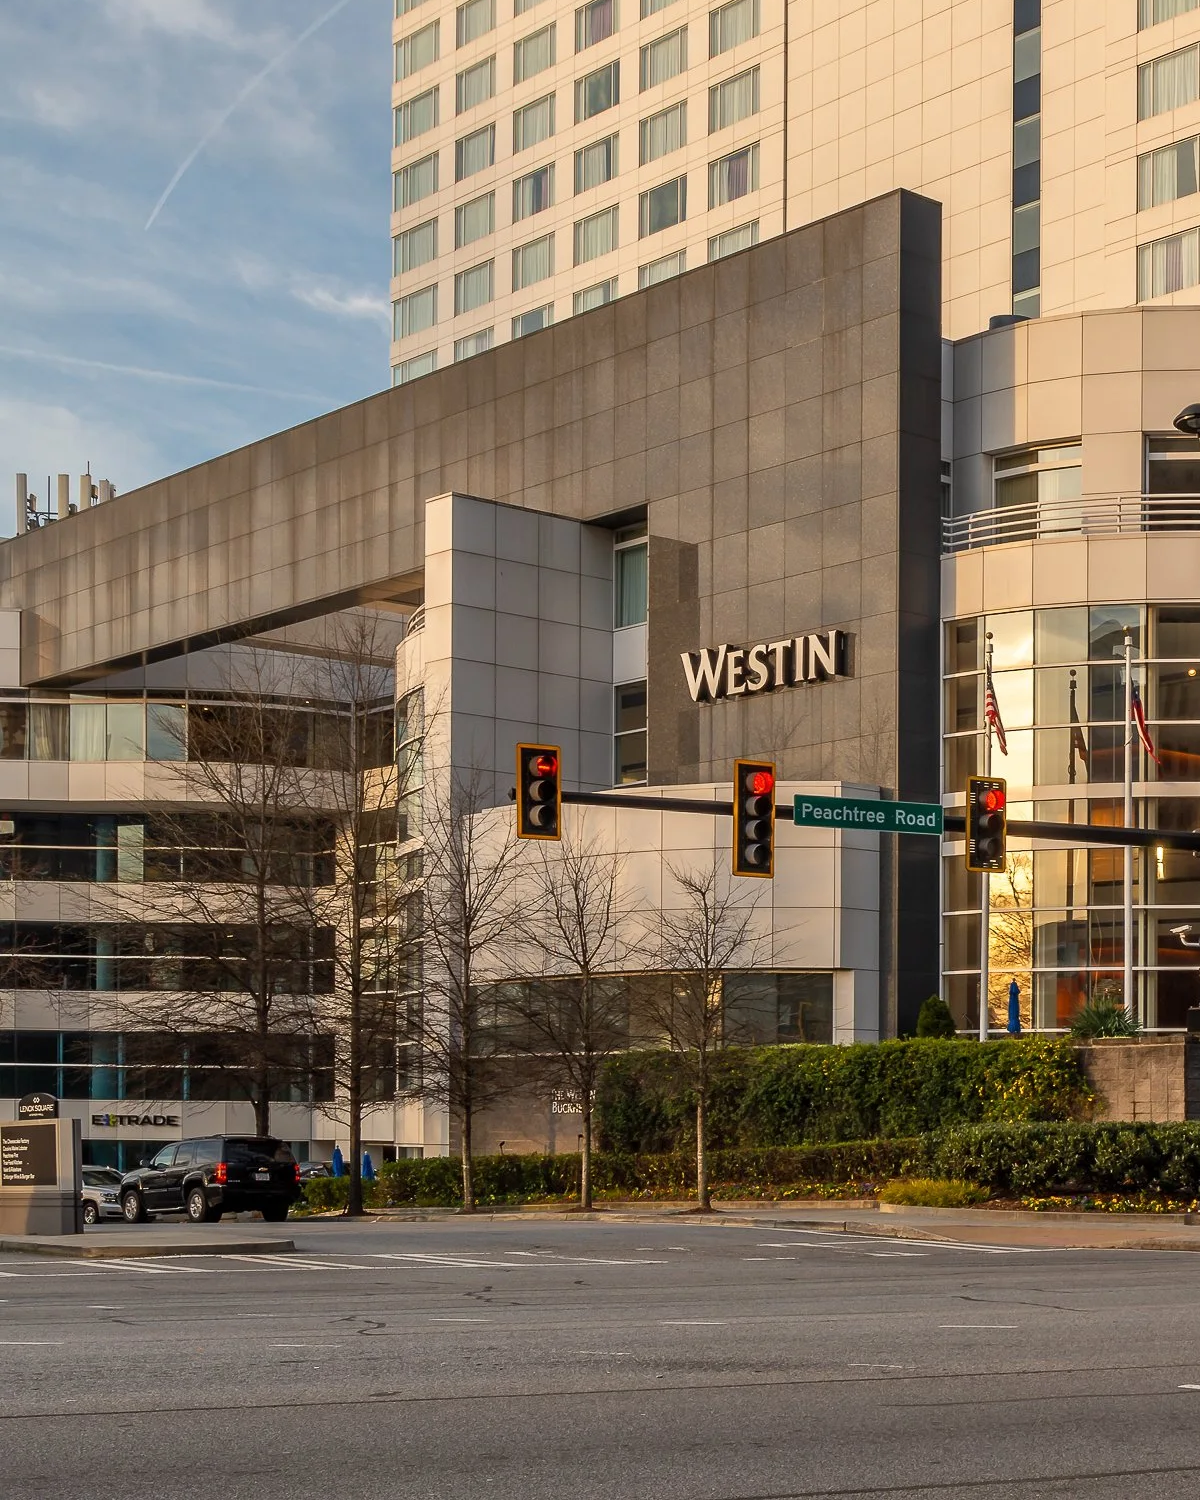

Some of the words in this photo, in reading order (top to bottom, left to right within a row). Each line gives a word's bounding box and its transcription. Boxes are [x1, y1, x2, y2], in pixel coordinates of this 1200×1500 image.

[680, 629, 844, 702] WESTIN
[801, 802, 885, 823] Peachtree
[895, 809, 936, 827] Road
[35, 1103, 54, 1112] SQUARE
